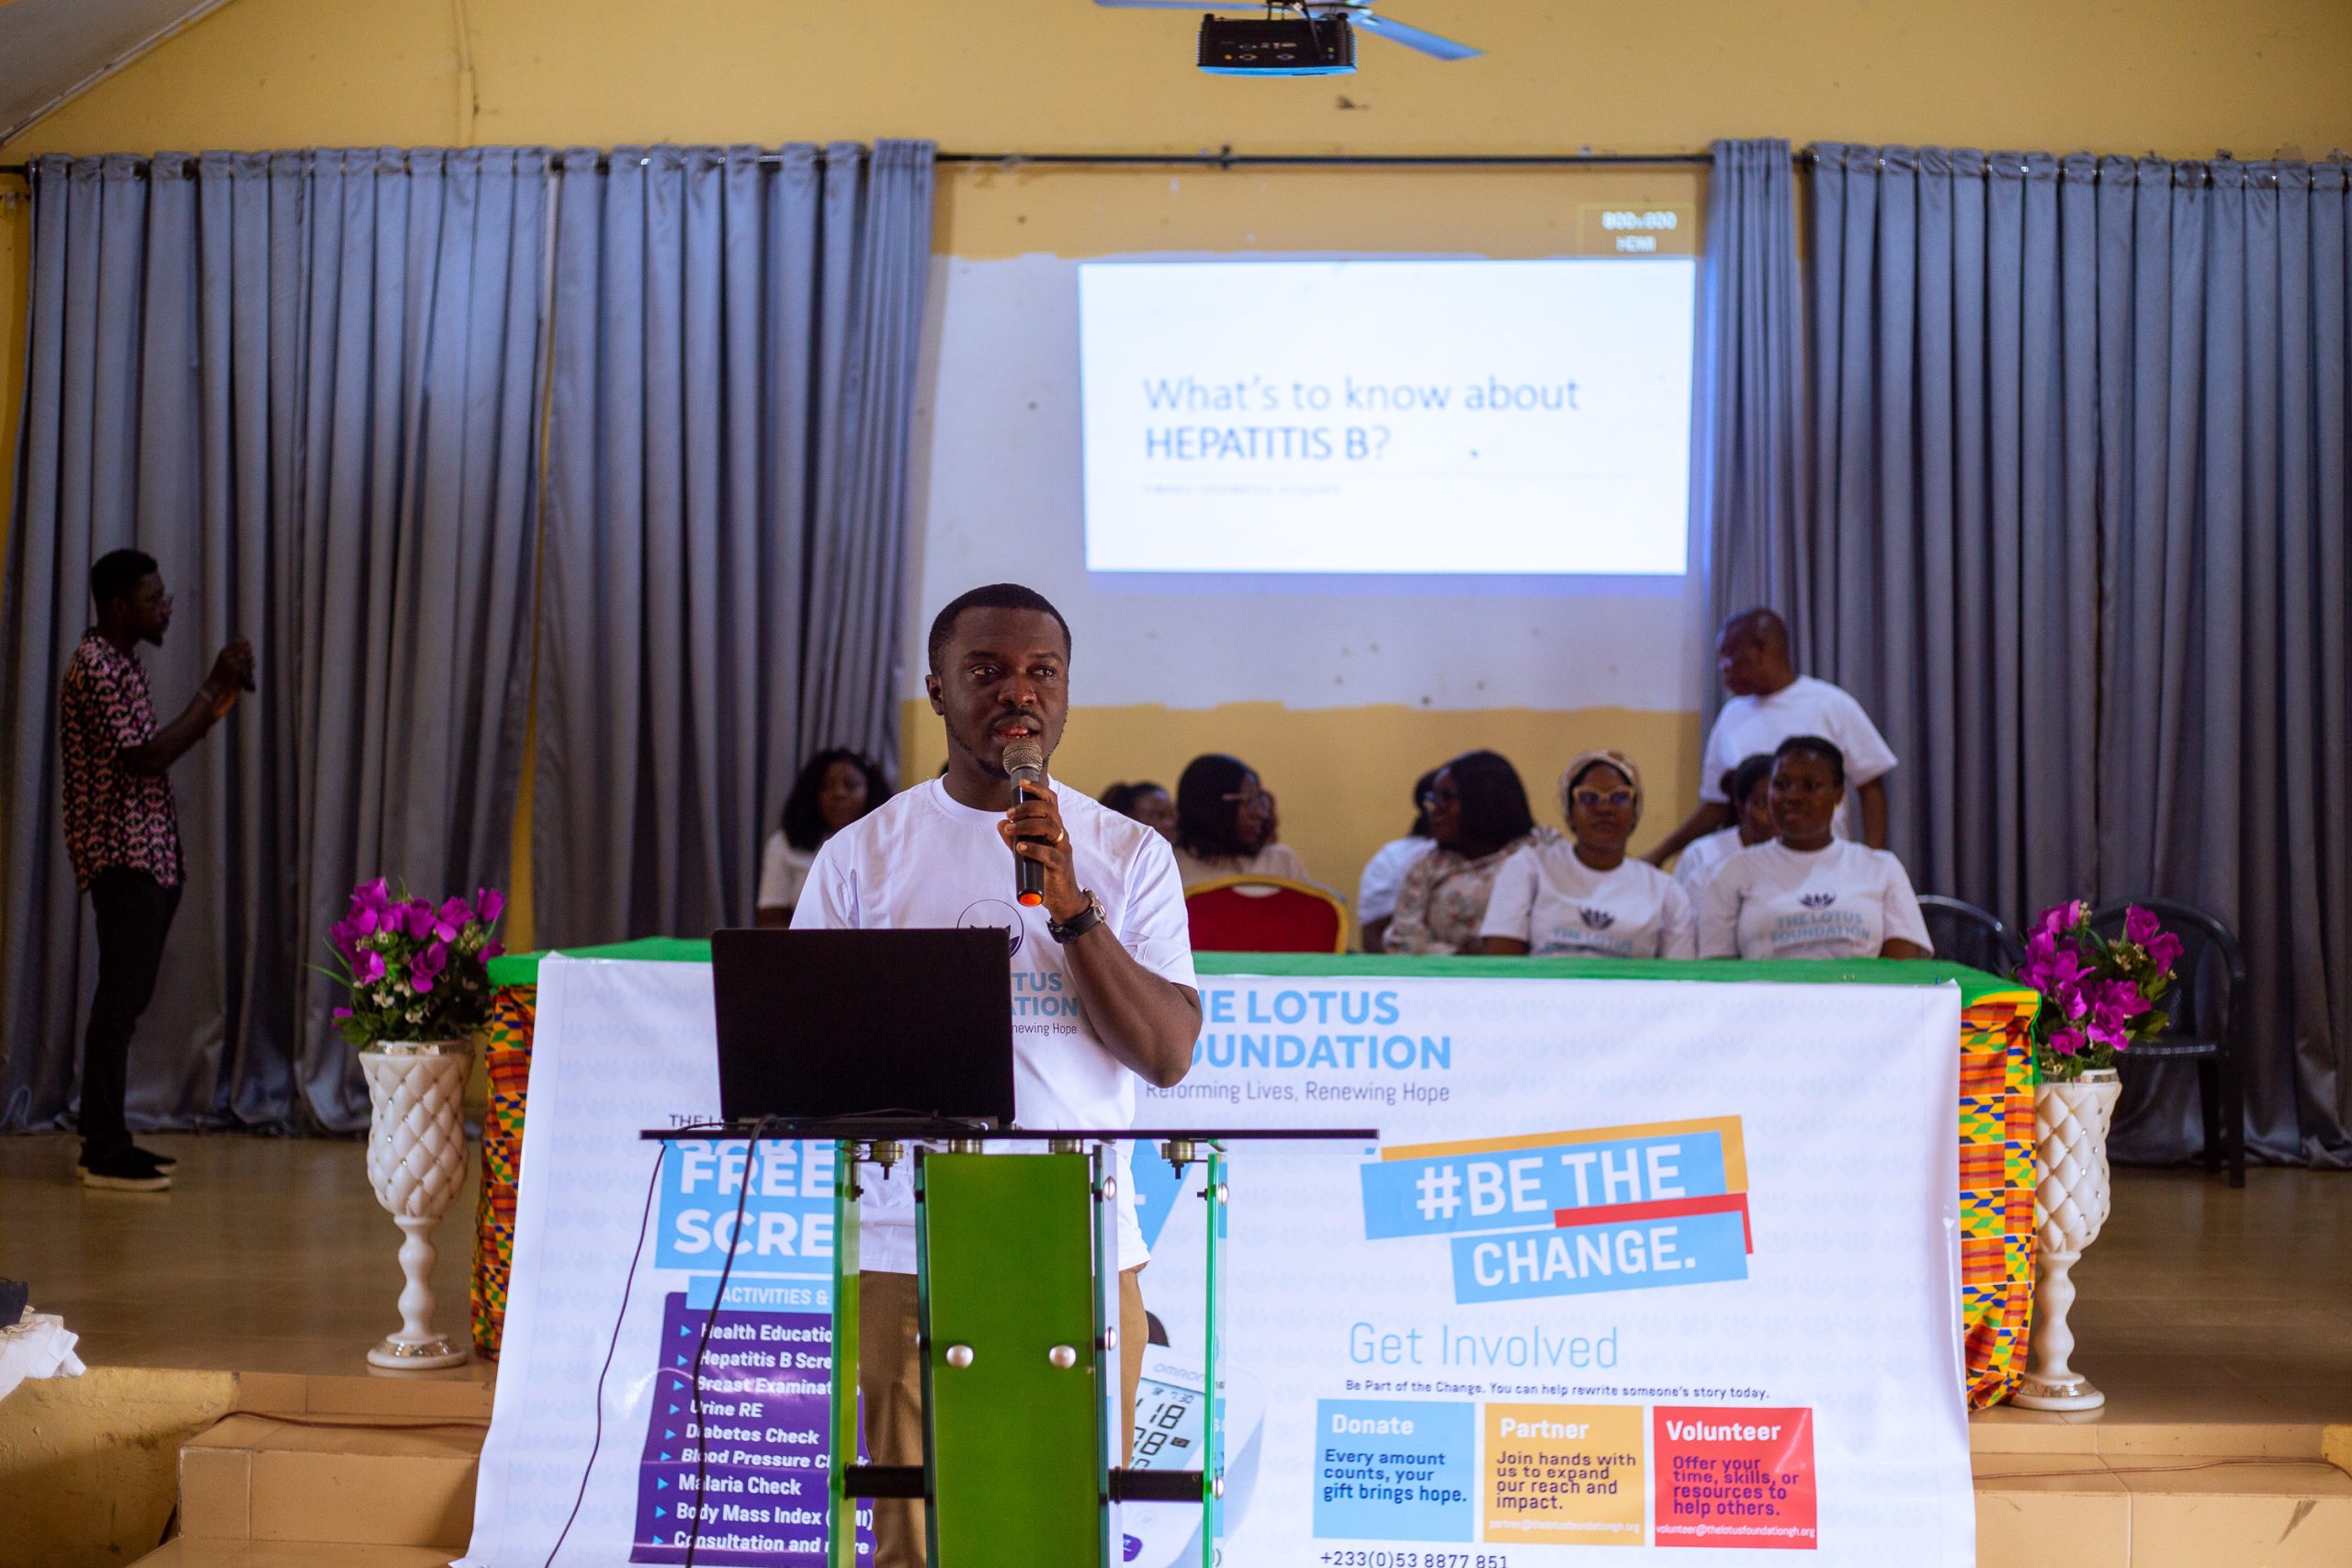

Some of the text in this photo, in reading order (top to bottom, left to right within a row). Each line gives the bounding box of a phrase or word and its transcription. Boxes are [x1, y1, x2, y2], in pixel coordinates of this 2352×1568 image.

[1293, 382, 1331, 411] to
[1346, 375, 1452, 411] know
[1464, 374, 1579, 411] about
[1146, 425, 1392, 460] HEPATITIS B?
[1012, 972, 1063, 992] TUS
[1248, 990, 1400, 1025] LOTUS
[1012, 1022, 1077, 1037] newing Hope
[1192, 1033, 1451, 1070] UNDATION
[1247, 1081, 1298, 1102] Lives,
[1306, 1080, 1396, 1106] Renewing
[1403, 1082, 1451, 1106] Hope
[669, 1114, 702, 1129] THE
[681, 1150, 835, 1199] FREE
[1416, 1144, 1686, 1221] #BE THE
[673, 1208, 835, 1258] SCRE
[1473, 1225, 1697, 1288] CHANGE.
[721, 1287, 830, 1305] ACTIVITIES &
[760, 1324, 833, 1343] Educatio
[1349, 1322, 1618, 1369] Get Involved
[700, 1349, 832, 1370] Hepatitis B Scre
[698, 1375, 752, 1393] Breast
[1346, 1380, 1770, 1401] Be Part of the Change. You can help rewrite someone's story today.
[739, 1402, 763, 1418] RE
[1332, 1414, 1415, 1436] Donate
[1500, 1417, 1589, 1440] Partner
[1666, 1420, 1781, 1442] Volunteer
[765, 1427, 820, 1445] Check
[732, 1450, 811, 1468] Pressure
[1325, 1449, 1446, 1467] Every amount
[1497, 1451, 1636, 1467] Join hands with
[1673, 1456, 1762, 1473] Offer your
[1324, 1468, 1434, 1484] counts, your
[1497, 1466, 1610, 1482] us to expand
[1673, 1470, 1800, 1486] time, skills, or
[748, 1476, 802, 1496] Check
[1323, 1483, 1467, 1506] gift brings hope.
[1497, 1480, 1618, 1495] our reach and
[1673, 1485, 1787, 1500] resources to
[1497, 1493, 1564, 1513] impact.
[1674, 1499, 1781, 1518] help others.
[676, 1502, 719, 1525] Body
[723, 1504, 770, 1523] Mass
[775, 1506, 823, 1526] Index
[788, 1537, 821, 1553] and
[1320, 1551, 1509, 1568] +233(0)53 8877 851
